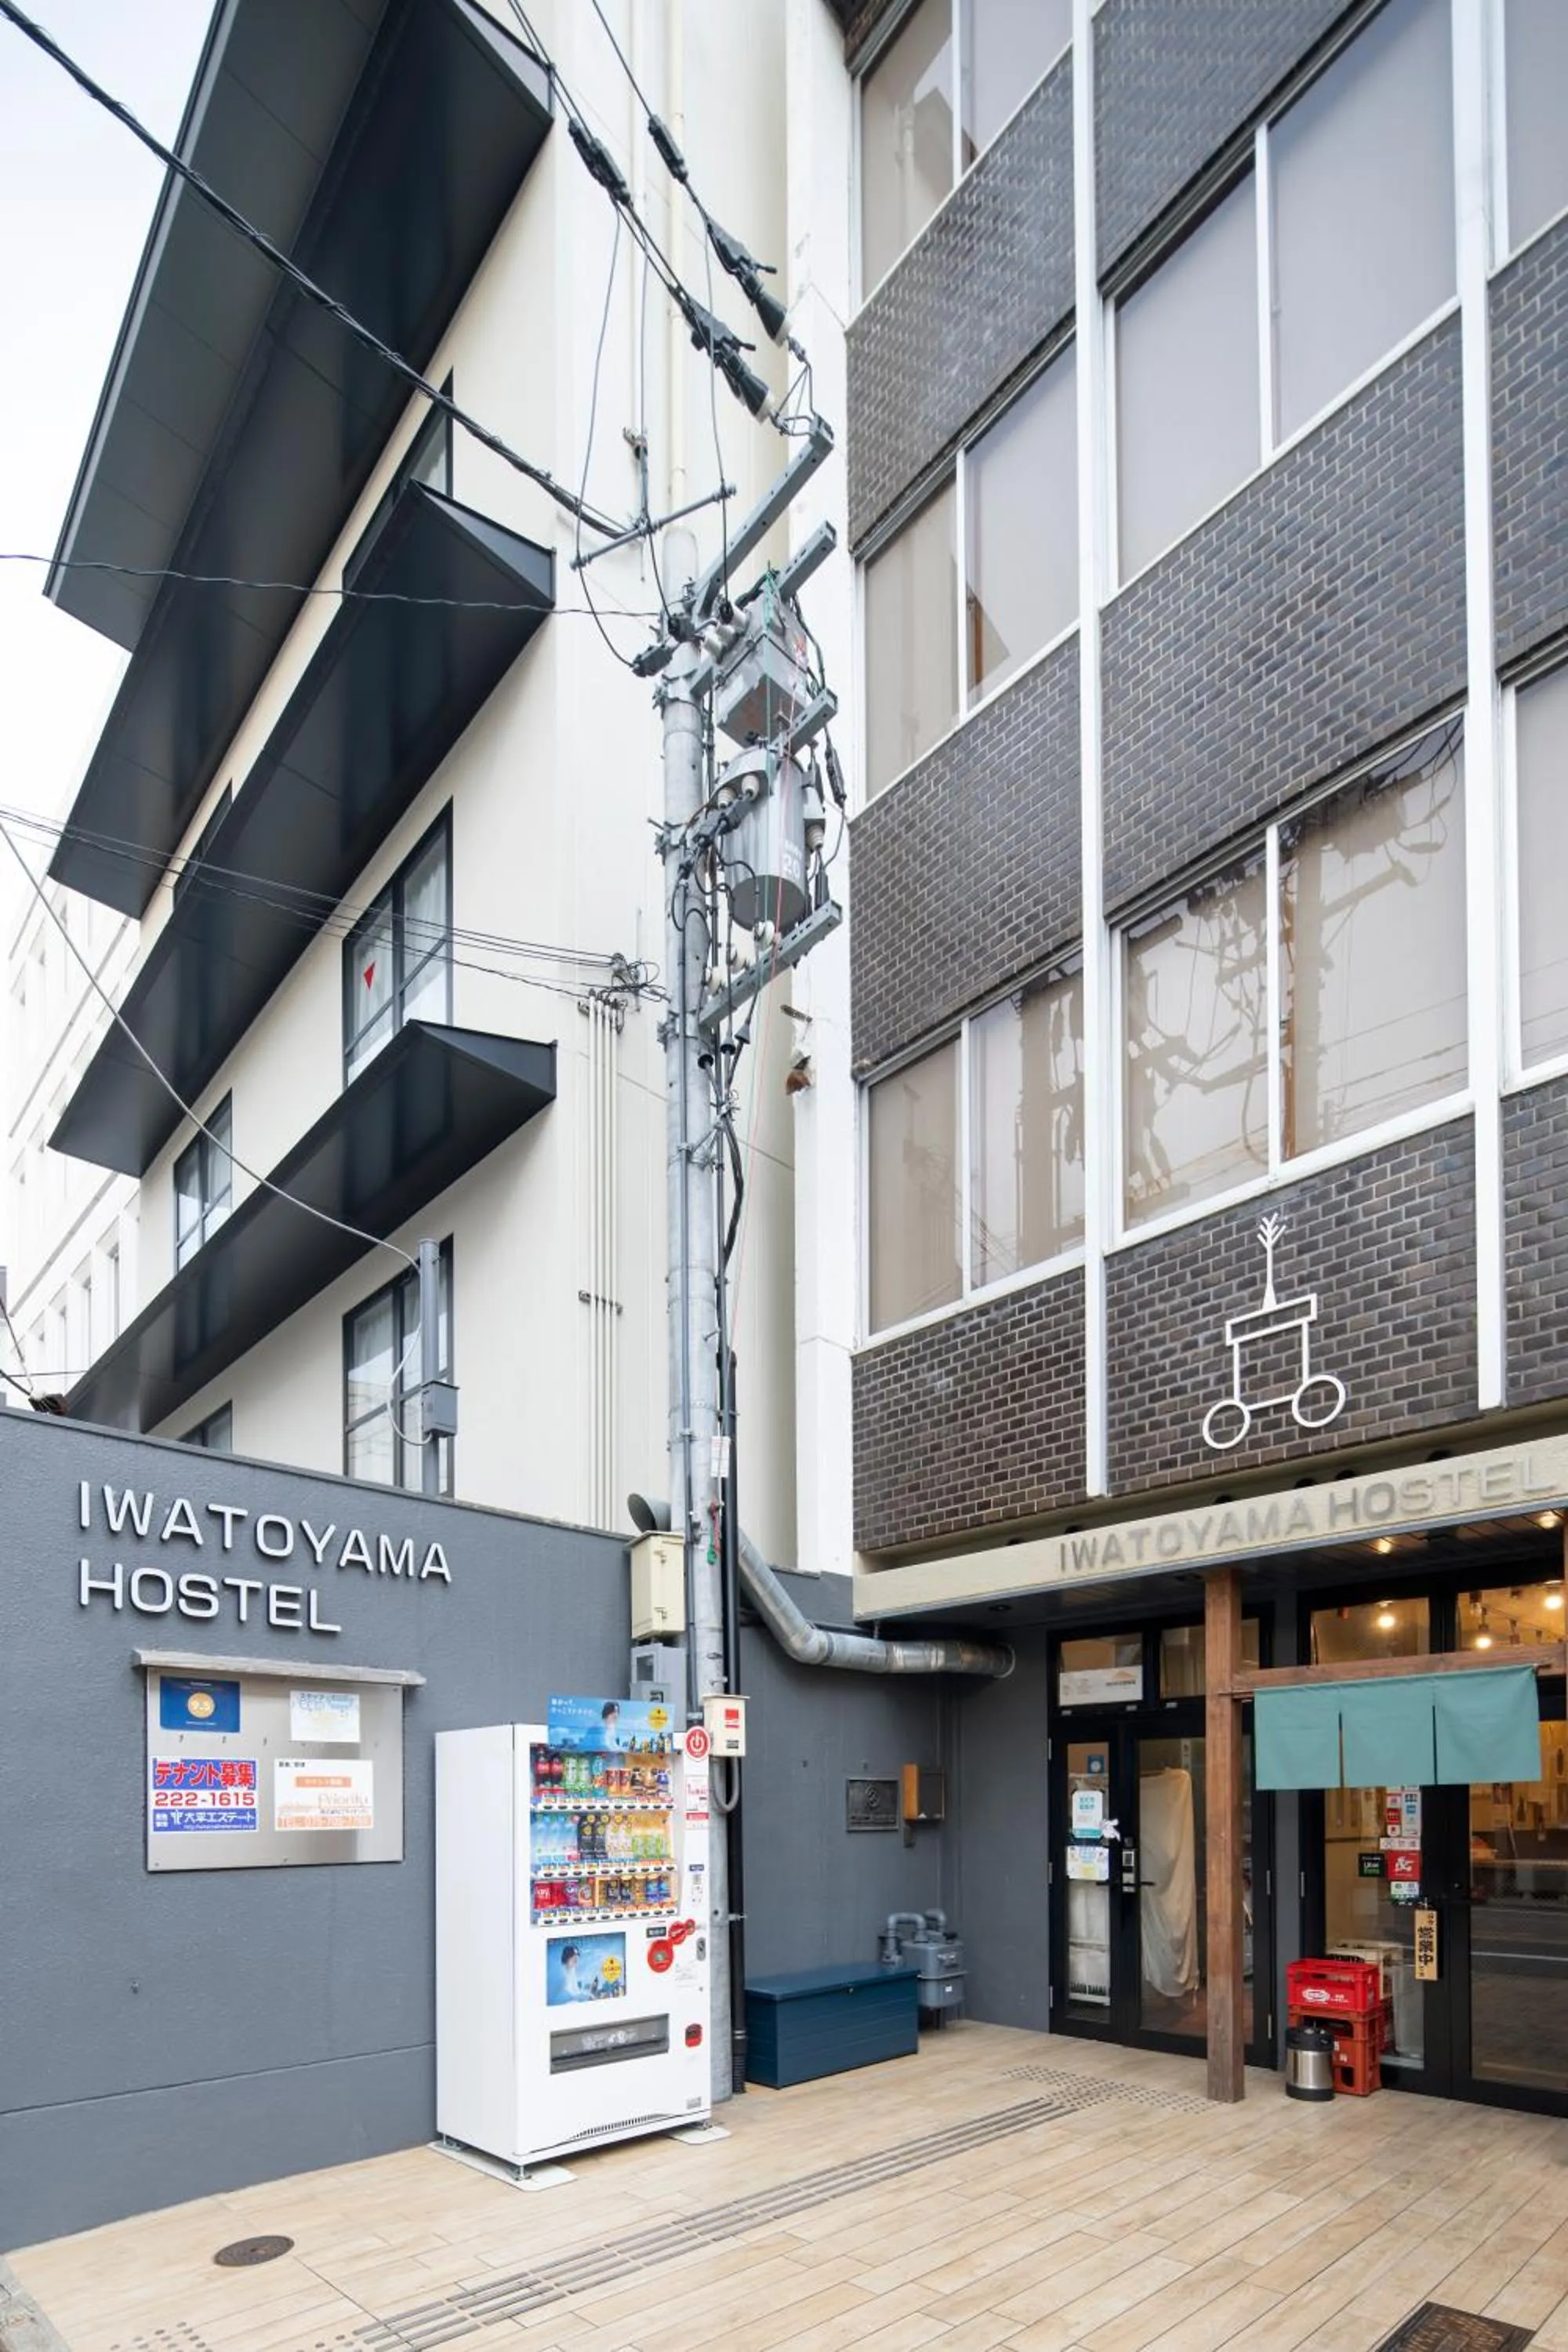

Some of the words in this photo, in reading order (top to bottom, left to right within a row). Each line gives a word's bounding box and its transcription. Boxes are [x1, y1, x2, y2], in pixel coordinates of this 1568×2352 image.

[79, 1479, 452, 1584] IWATOYAMA
[1058, 1495, 1316, 1571] IWATOYAMA
[1330, 1454, 1558, 1527] HOSTEL
[79, 1557, 343, 1632] HOSTEL
[154, 1791, 256, 1806] 222-1615
[155, 1761, 252, 1787] テナント募集
[1417, 1926, 1435, 1966] 営業中
